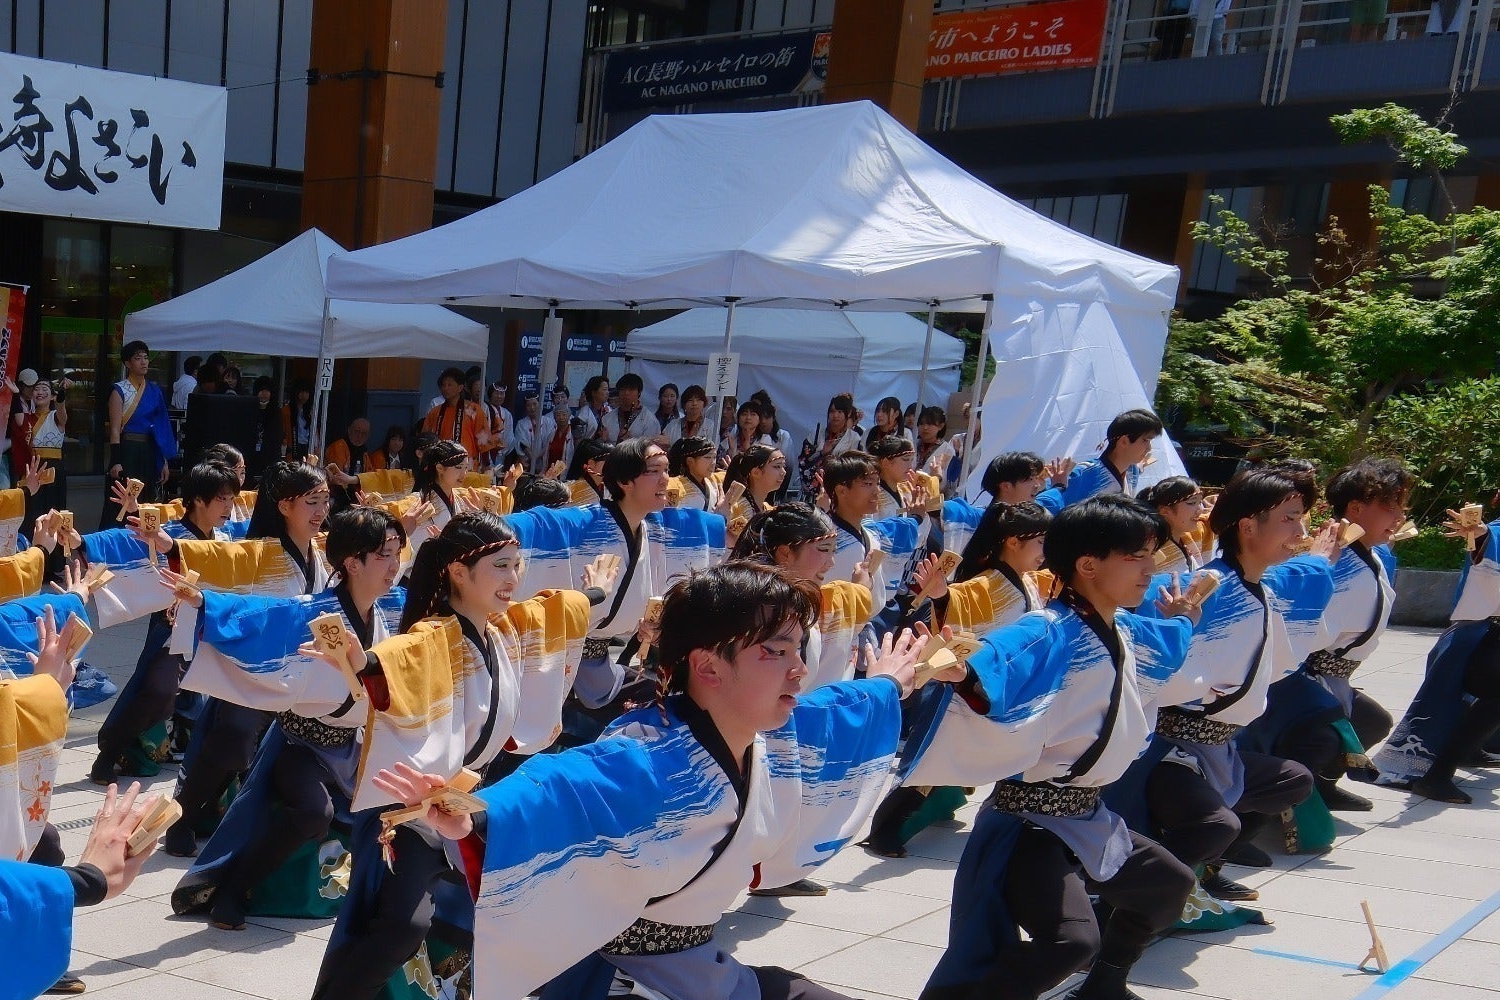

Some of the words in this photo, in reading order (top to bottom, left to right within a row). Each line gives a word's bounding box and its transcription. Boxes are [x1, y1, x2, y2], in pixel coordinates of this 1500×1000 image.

[954, 48, 1019, 64] PARCEIRO
[1023, 43, 1072, 58] LADIES
[641, 86, 657, 98] AC
[659, 81, 708, 97] NAGANO
[711, 74, 768, 91] PARCEIRO
